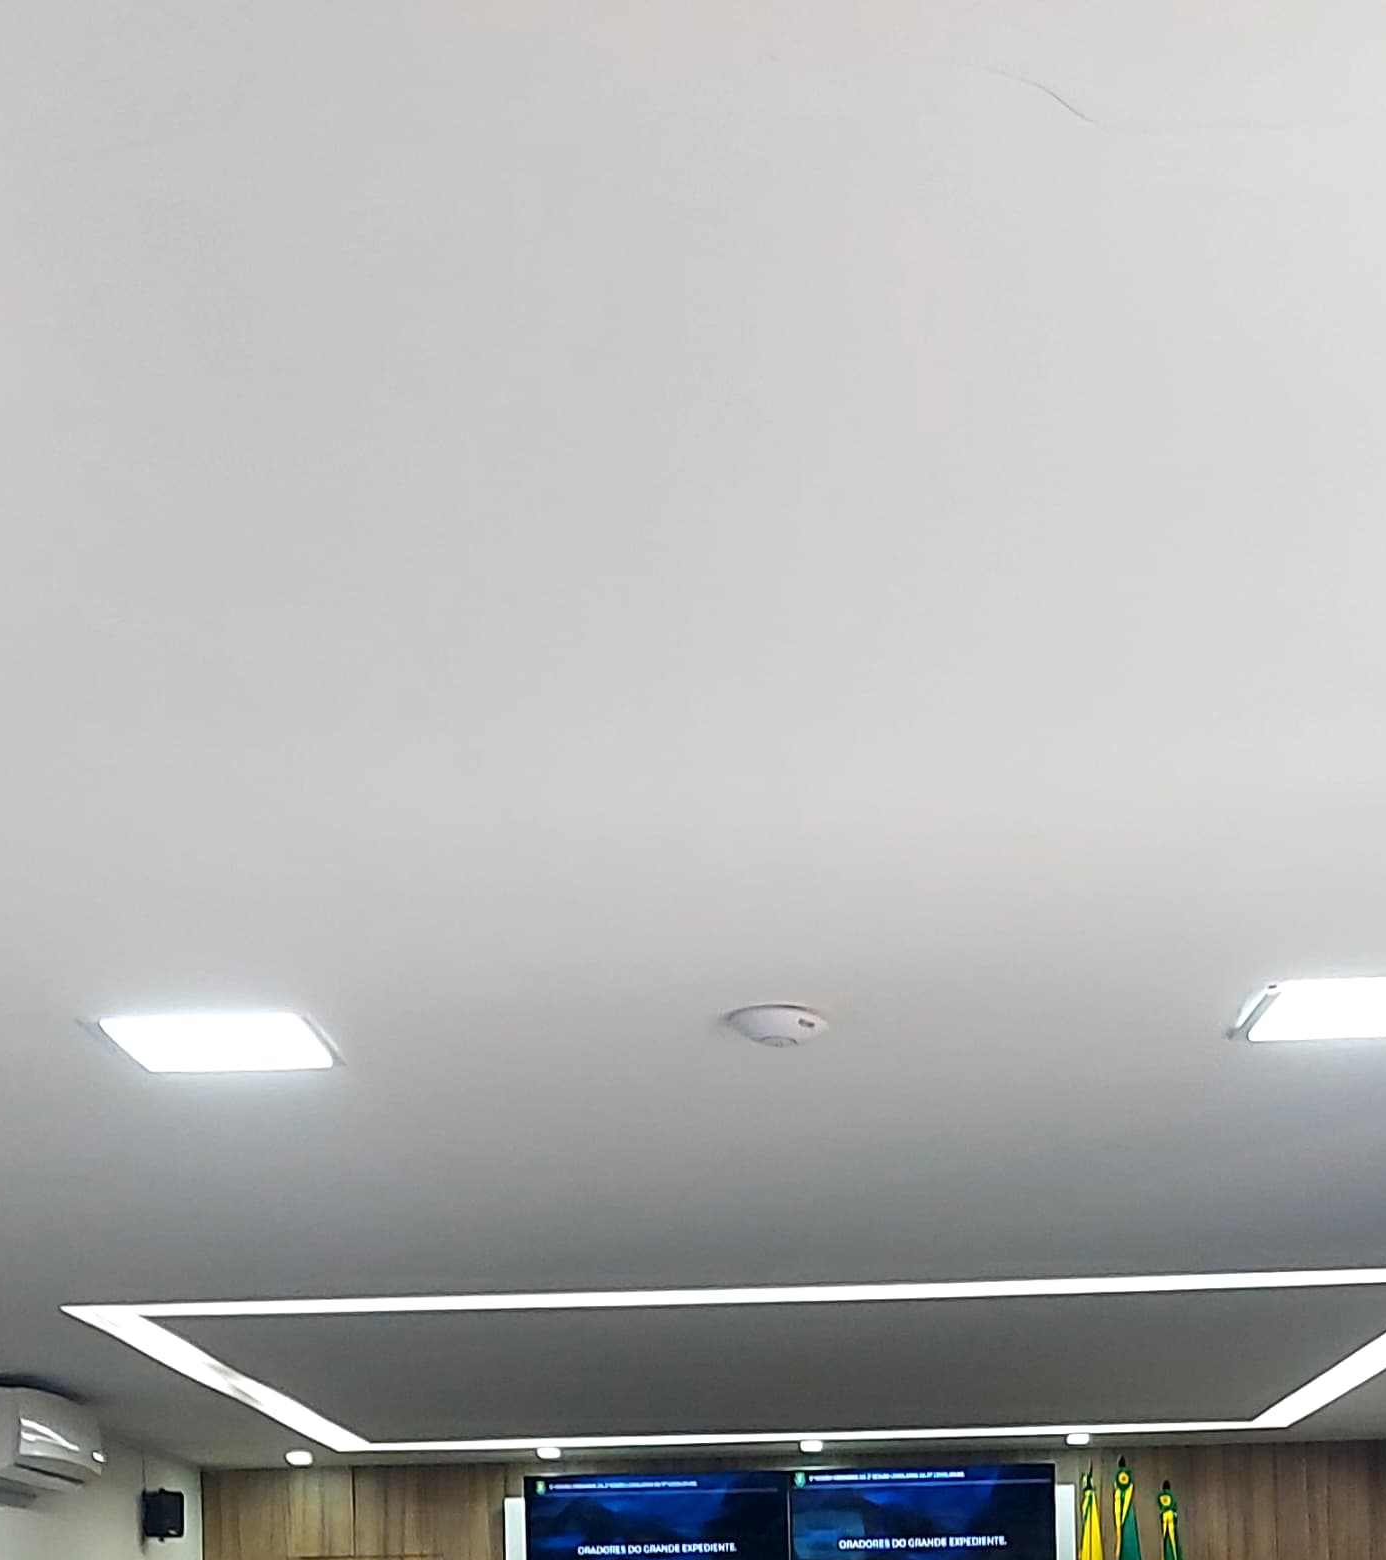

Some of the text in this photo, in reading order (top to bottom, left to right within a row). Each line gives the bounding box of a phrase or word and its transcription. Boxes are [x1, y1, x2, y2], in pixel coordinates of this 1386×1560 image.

[577, 1544, 627, 1555] ORADORES
[627, 1544, 642, 1555] DO
[643, 1543, 680, 1554] GRANDE
[837, 1538, 891, 1550] ORADORES
[891, 1538, 907, 1549] DO
[907, 1537, 948, 1549] GRANDE
